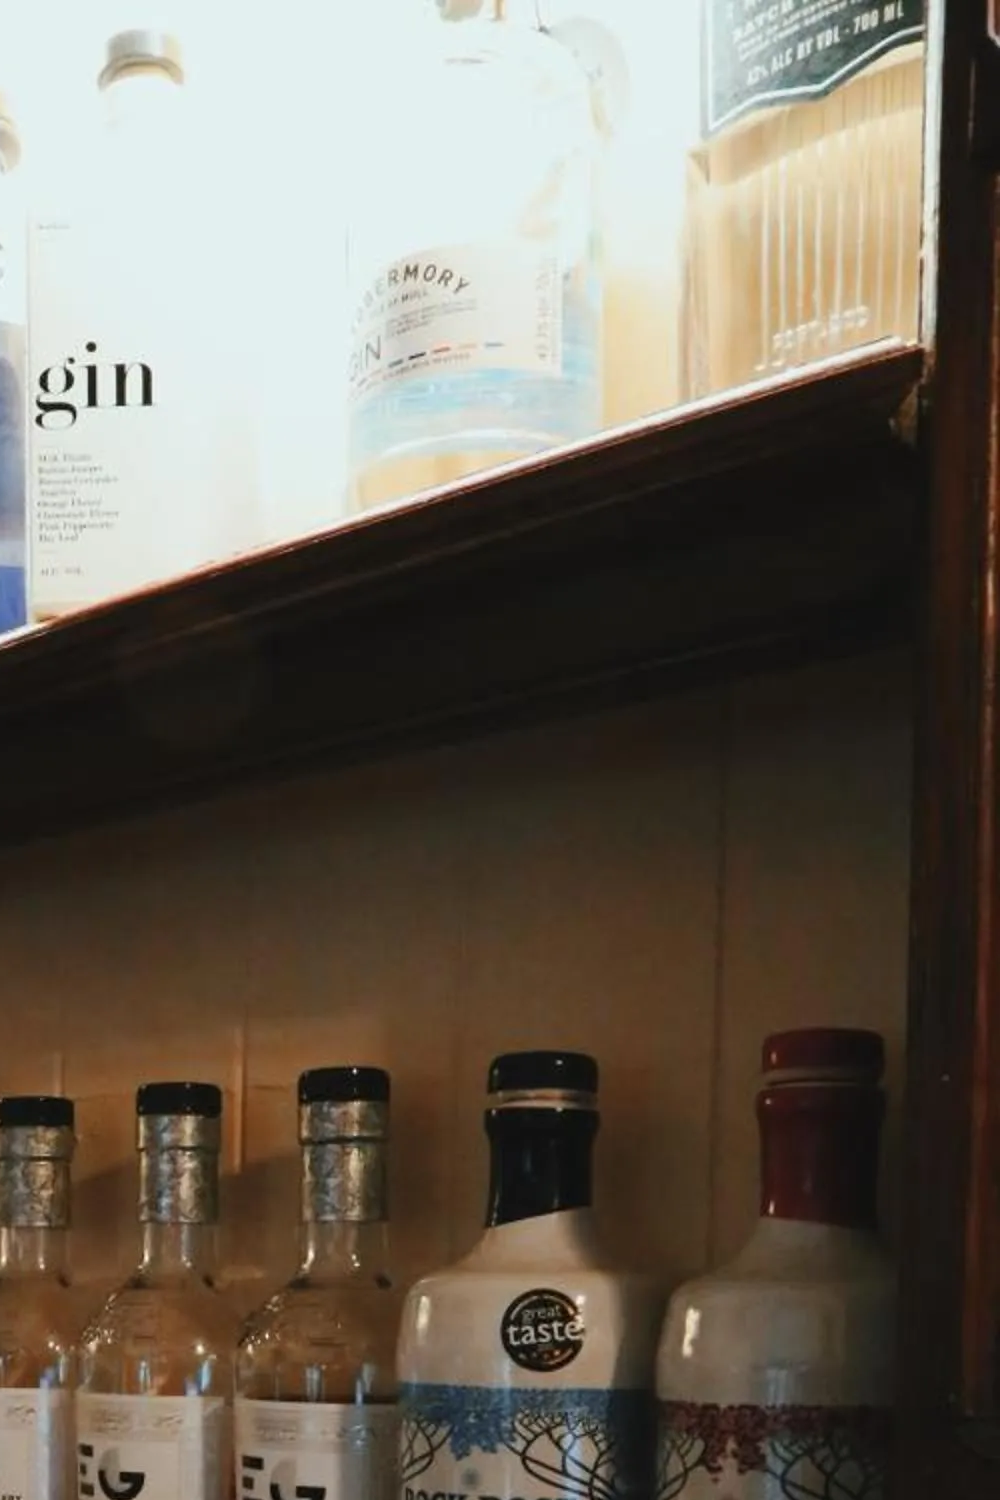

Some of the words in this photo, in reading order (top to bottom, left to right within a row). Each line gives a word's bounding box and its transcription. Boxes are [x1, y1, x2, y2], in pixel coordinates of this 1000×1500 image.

[853, 10, 879, 35] 700
[34, 340, 155, 432] gin
[507, 1320, 584, 1346] taste
